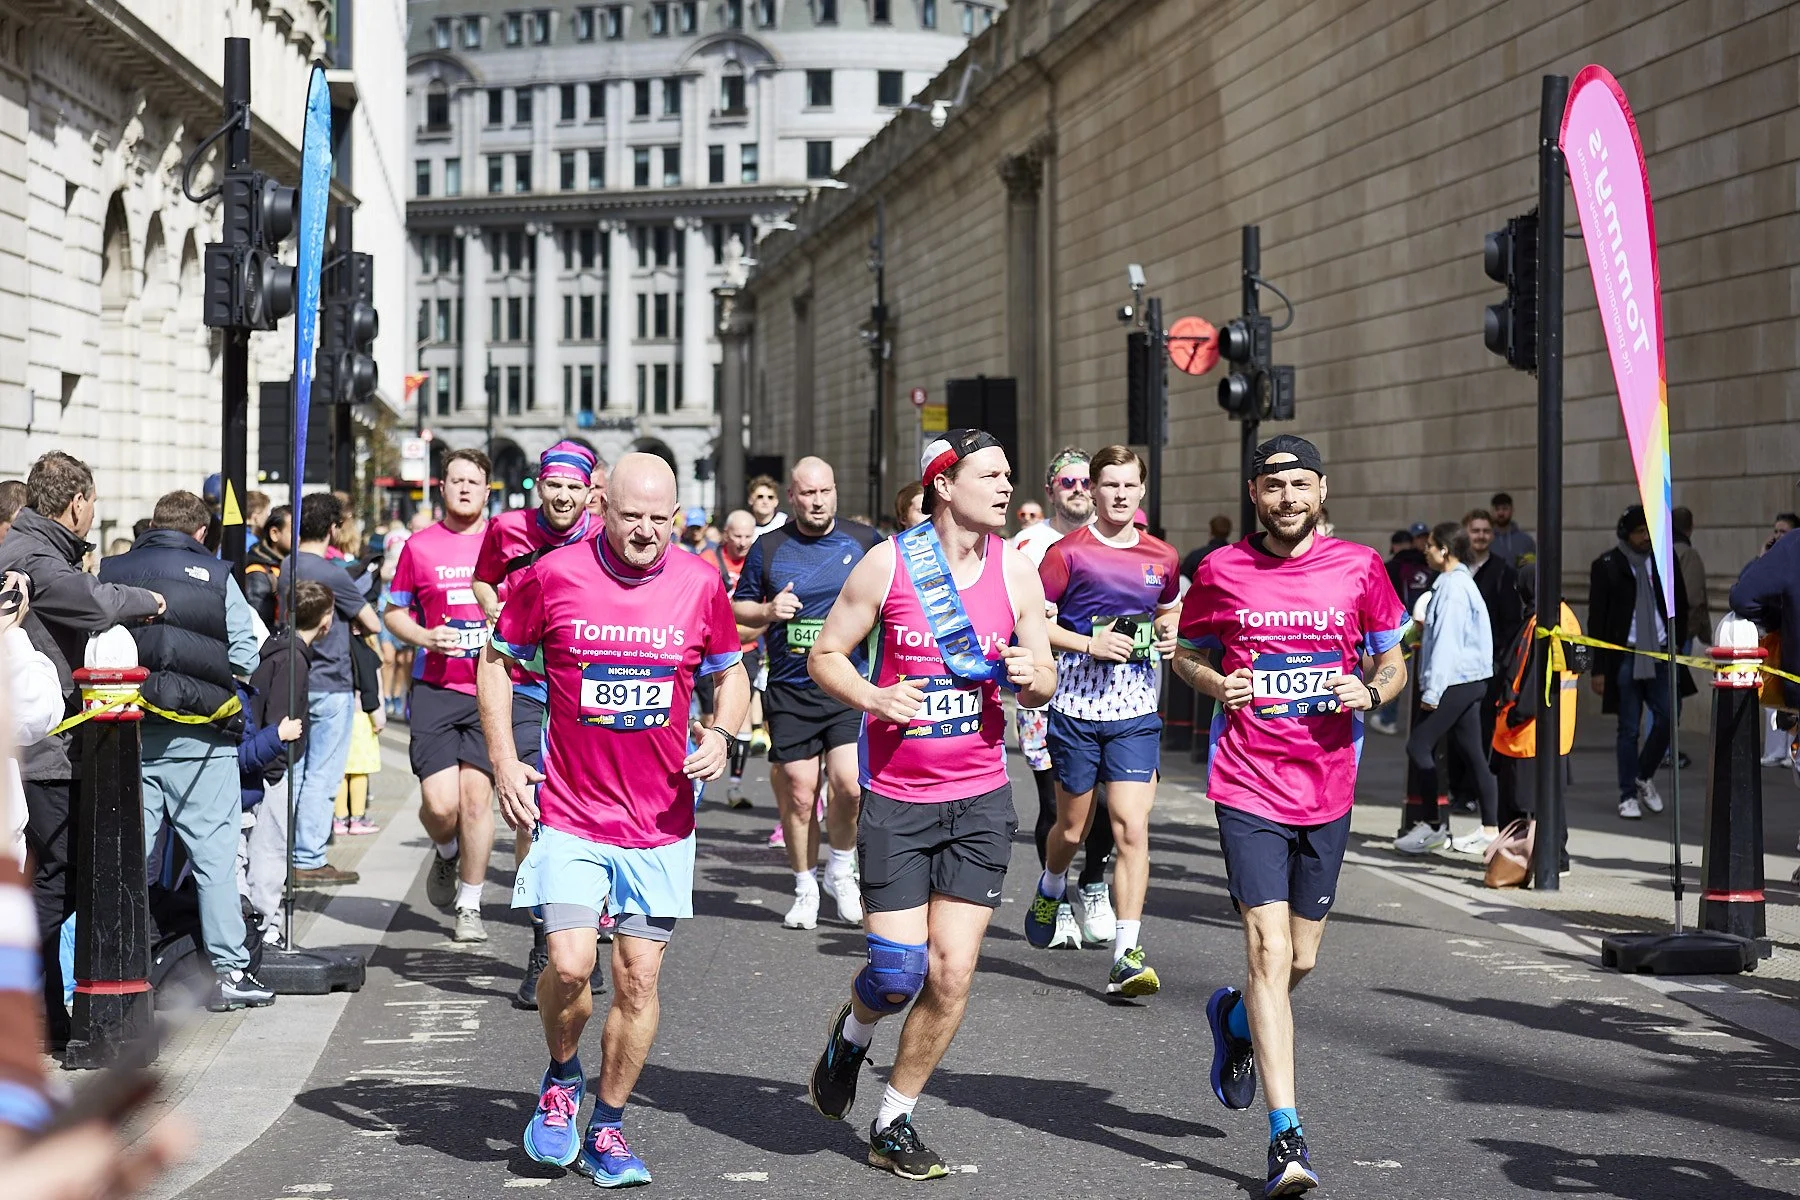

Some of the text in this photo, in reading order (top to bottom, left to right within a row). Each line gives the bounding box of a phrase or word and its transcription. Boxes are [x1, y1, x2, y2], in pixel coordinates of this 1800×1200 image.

[1235, 607, 1345, 631] Tommy's
[570, 619, 685, 649] Tommy's
[893, 625, 1006, 656] Tomy's
[1303, 633, 1320, 641] baby
[569, 646, 683, 662] The pregnancy and baby charity
[1286, 655, 1313, 664] GIACO
[608, 667, 651, 676] NICHOLAS
[934, 678, 953, 686] TOM
[595, 683, 661, 706] 8912
[924, 690, 979, 716] 1417
